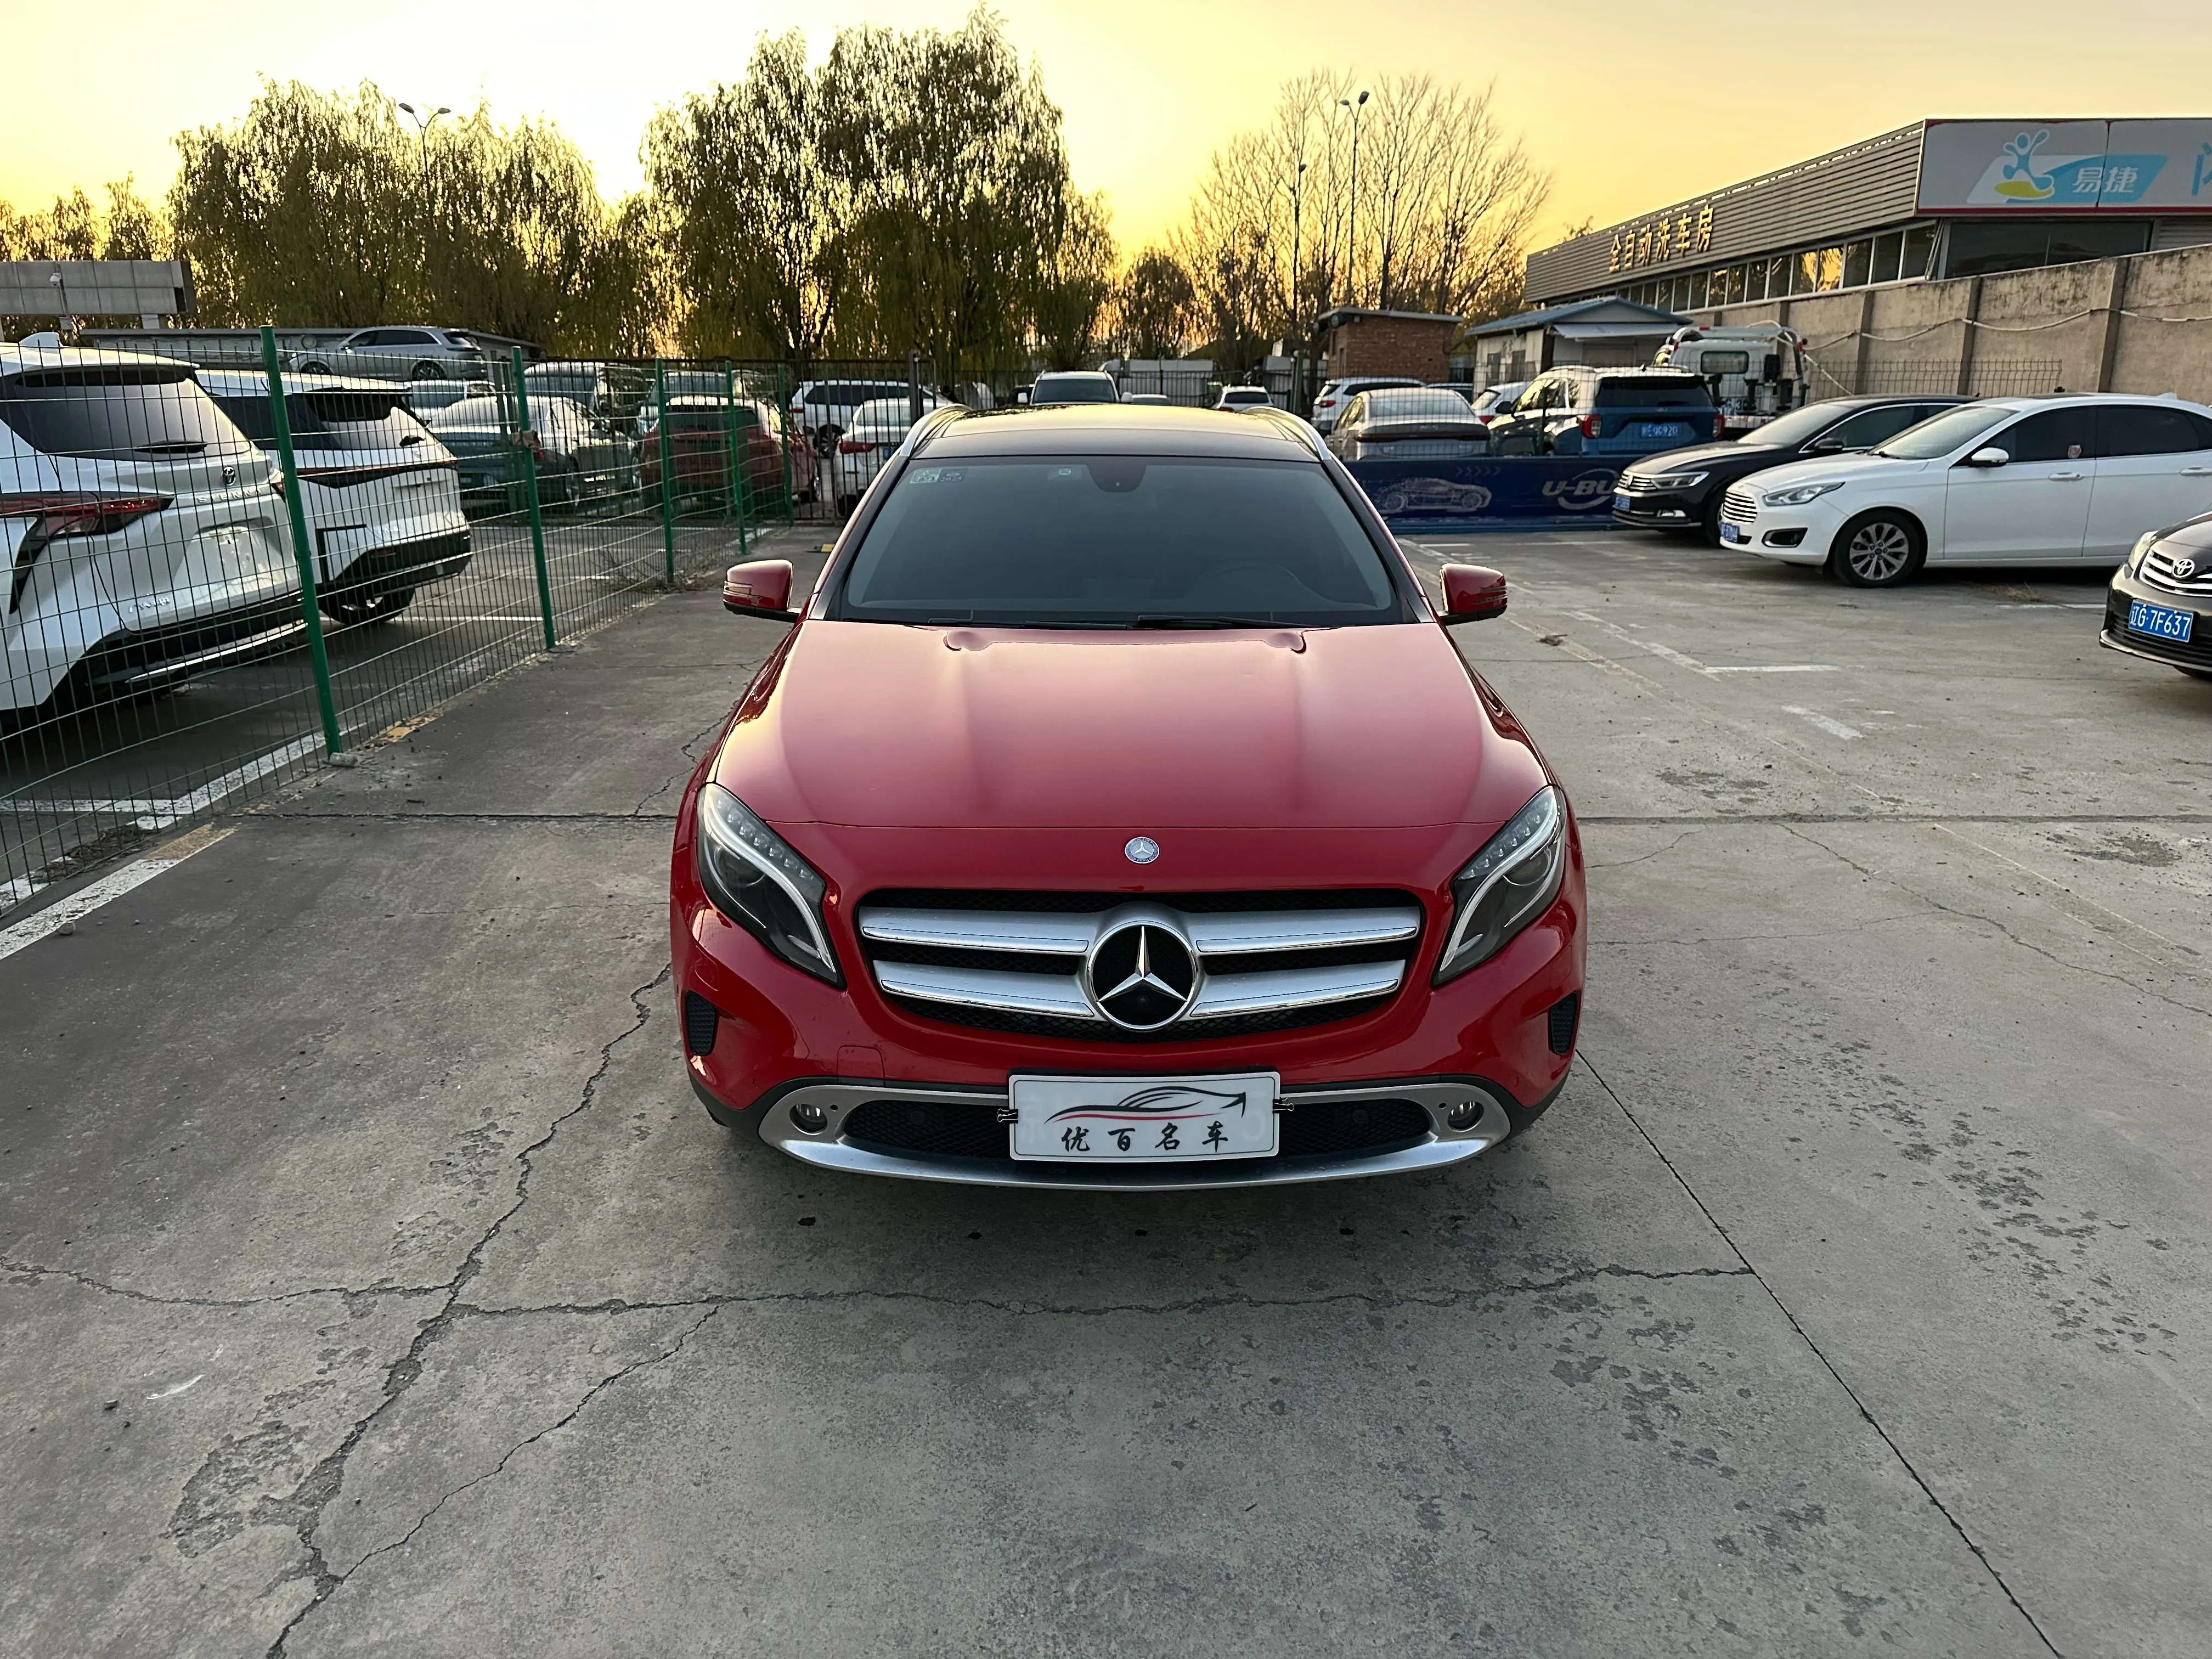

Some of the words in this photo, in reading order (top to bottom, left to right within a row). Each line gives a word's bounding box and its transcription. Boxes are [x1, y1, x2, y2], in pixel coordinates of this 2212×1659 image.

[2072, 166, 2138, 193] 易捷
[1609, 204, 1713, 273] 全自动洗车房
[1061, 1120, 1228, 1153] 优百名车
